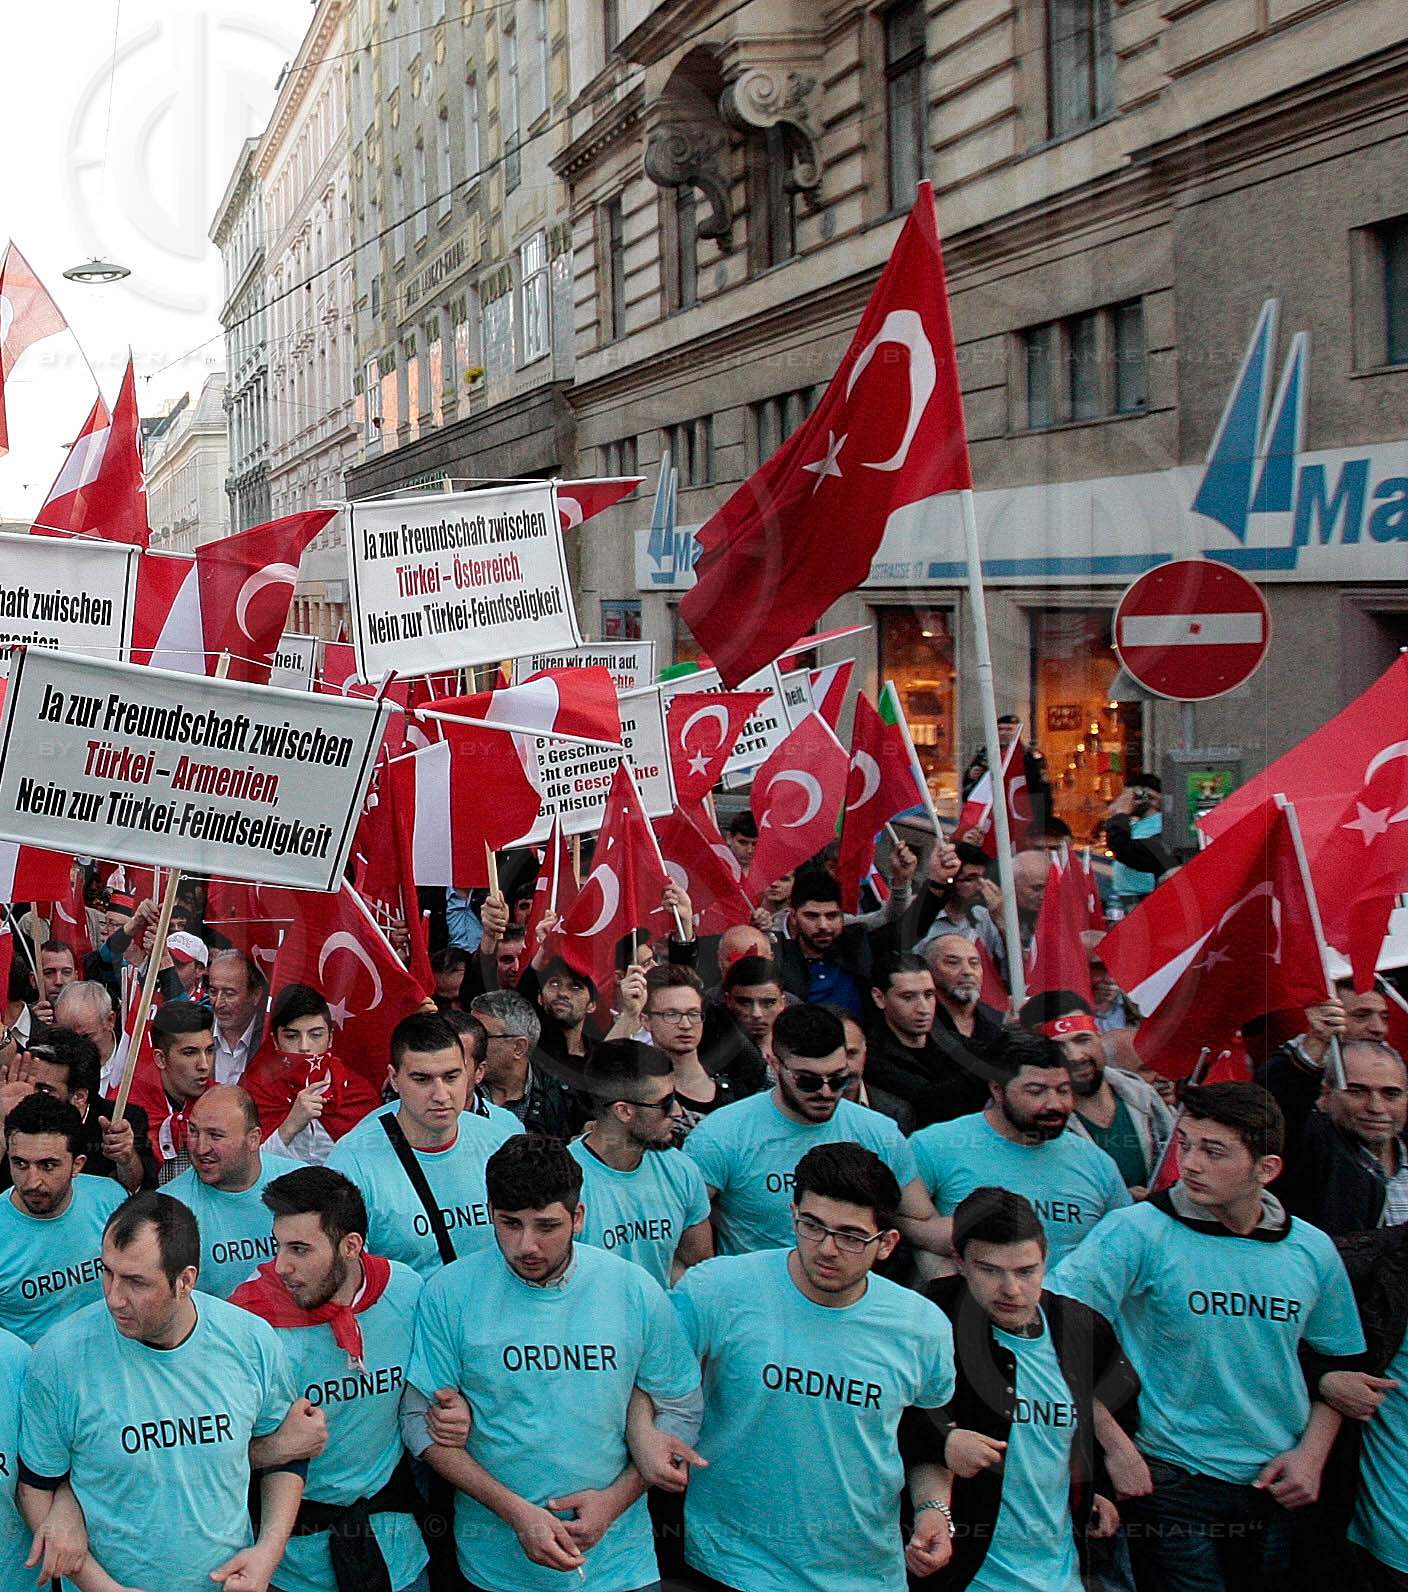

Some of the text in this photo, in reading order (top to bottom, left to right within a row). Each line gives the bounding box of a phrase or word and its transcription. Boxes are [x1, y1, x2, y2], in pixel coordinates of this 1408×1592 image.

[363, 509, 548, 561] Ja zur Freundschaft zwischen
[396, 561, 442, 598] Türkei
[453, 551, 524, 591] Österreich,
[32, 589, 113, 627] zwischen
[368, 585, 564, 645] Nein zur Türkei-Feindseligkeit
[565, 655, 584, 669] wir
[39, 684, 354, 768] Ja zur Freundschaft zwischen
[83, 740, 156, 785] Türkei
[171, 755, 279, 807] Armenien,
[547, 783, 571, 799] die
[15, 777, 333, 859] Nein zur Türkei-Feindseligkeit
[603, 1218, 673, 1250] ORDNER
[21, 1258, 105, 1300] ORDNER
[1188, 1290, 1301, 1323] ORDNER
[503, 1344, 617, 1372] ORDNER
[304, 1366, 403, 1407] ORDNER
[762, 1363, 882, 1411] ORDNER
[121, 1413, 234, 1455] ORDNER
